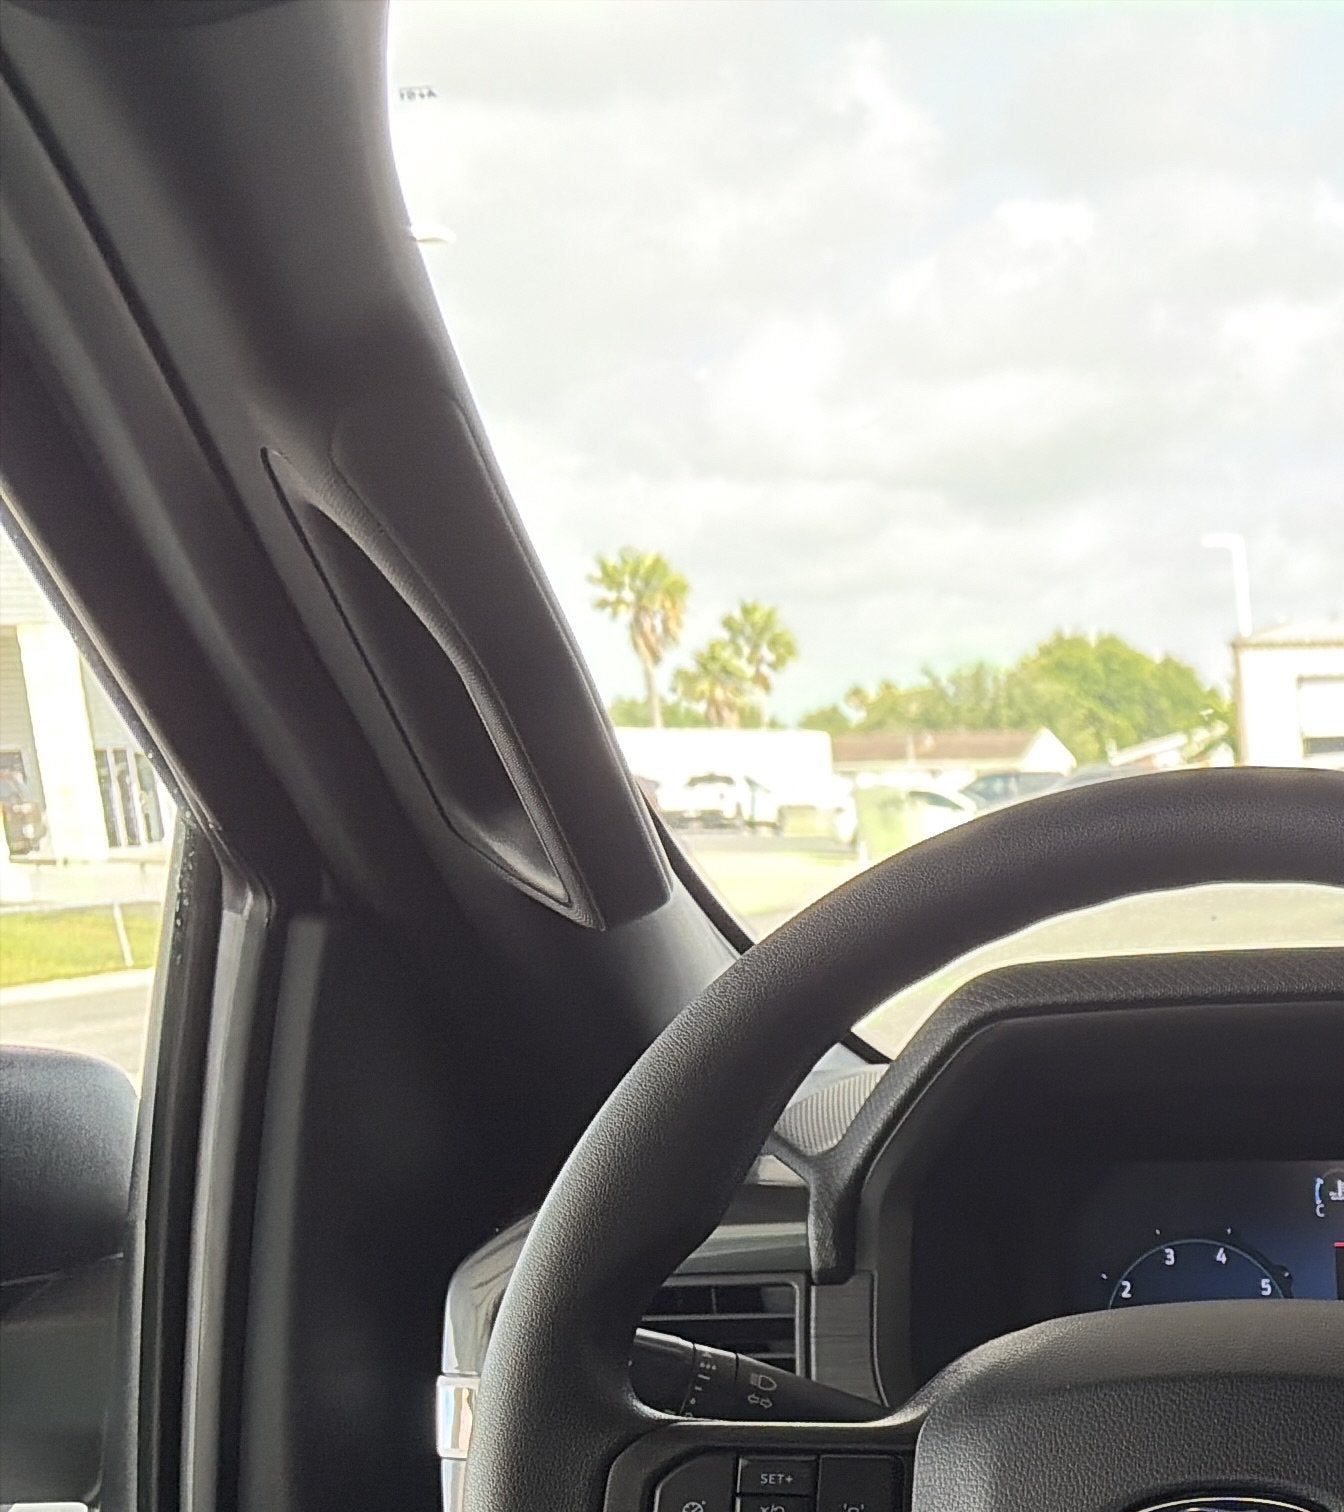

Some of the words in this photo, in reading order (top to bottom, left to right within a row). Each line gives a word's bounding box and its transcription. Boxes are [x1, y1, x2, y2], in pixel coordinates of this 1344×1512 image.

[1162, 1247, 1176, 1266] 3
[1215, 1246, 1228, 1265] 4
[1120, 1280, 1132, 1299] 2
[1259, 1277, 1272, 1297] 5
[760, 1473, 794, 1485] SET+
